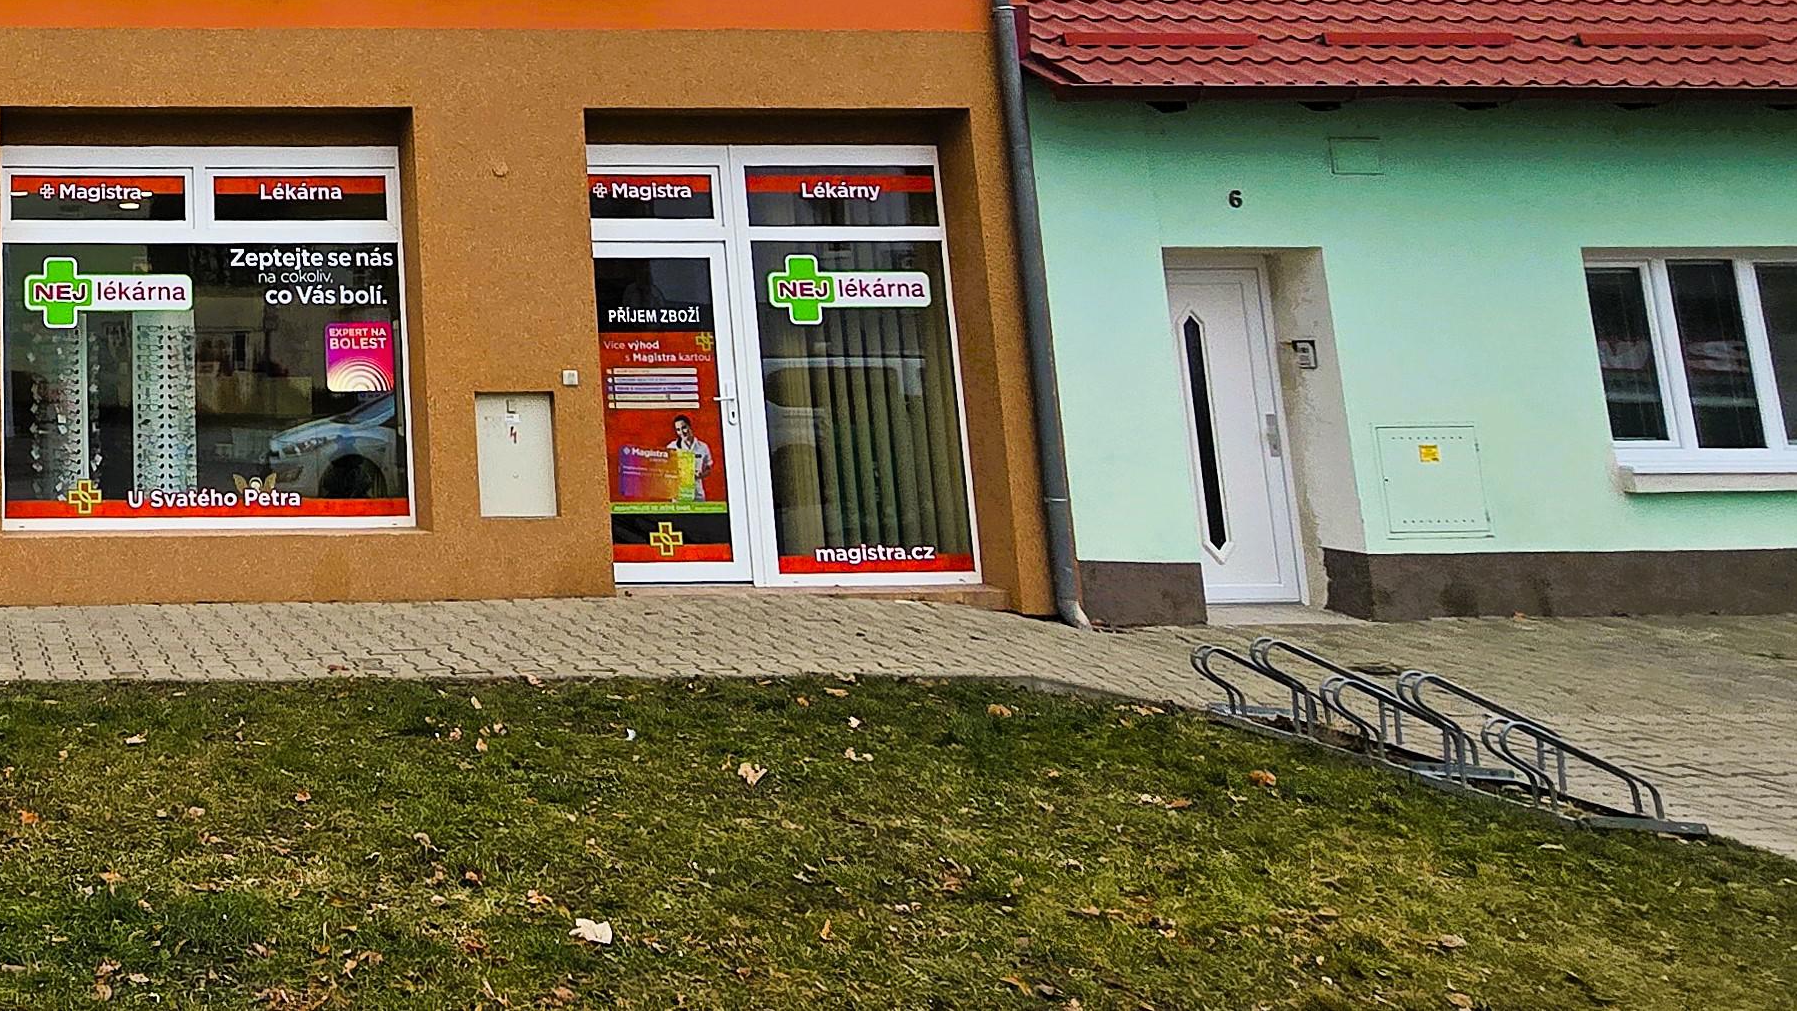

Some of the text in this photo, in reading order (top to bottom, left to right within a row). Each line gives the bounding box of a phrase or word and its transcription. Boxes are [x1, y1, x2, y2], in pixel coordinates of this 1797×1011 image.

[59, 182, 342, 201] Magistra Lékárna
[611, 181, 880, 201] Magistra Lékárny
[1228, 189, 1243, 208] 6
[230, 248, 393, 271] Zeptejte se nás
[258, 273, 277, 283] na
[777, 277, 925, 298] NEJ lékárna
[34, 276, 186, 301] NEJ lékárna
[265, 285, 388, 305] co Vás bolí.
[608, 306, 700, 323] PŘÍJEM ZBOŽÍ
[329, 327, 386, 337] EXPERT NA
[329, 338, 386, 350] BOLEST
[627, 340, 660, 351] výhod
[632, 353, 677, 363] Magistra
[678, 353, 711, 362] kartou
[127, 489, 301, 507] U Svatého Petra
[815, 544, 936, 564] magistra.cz
